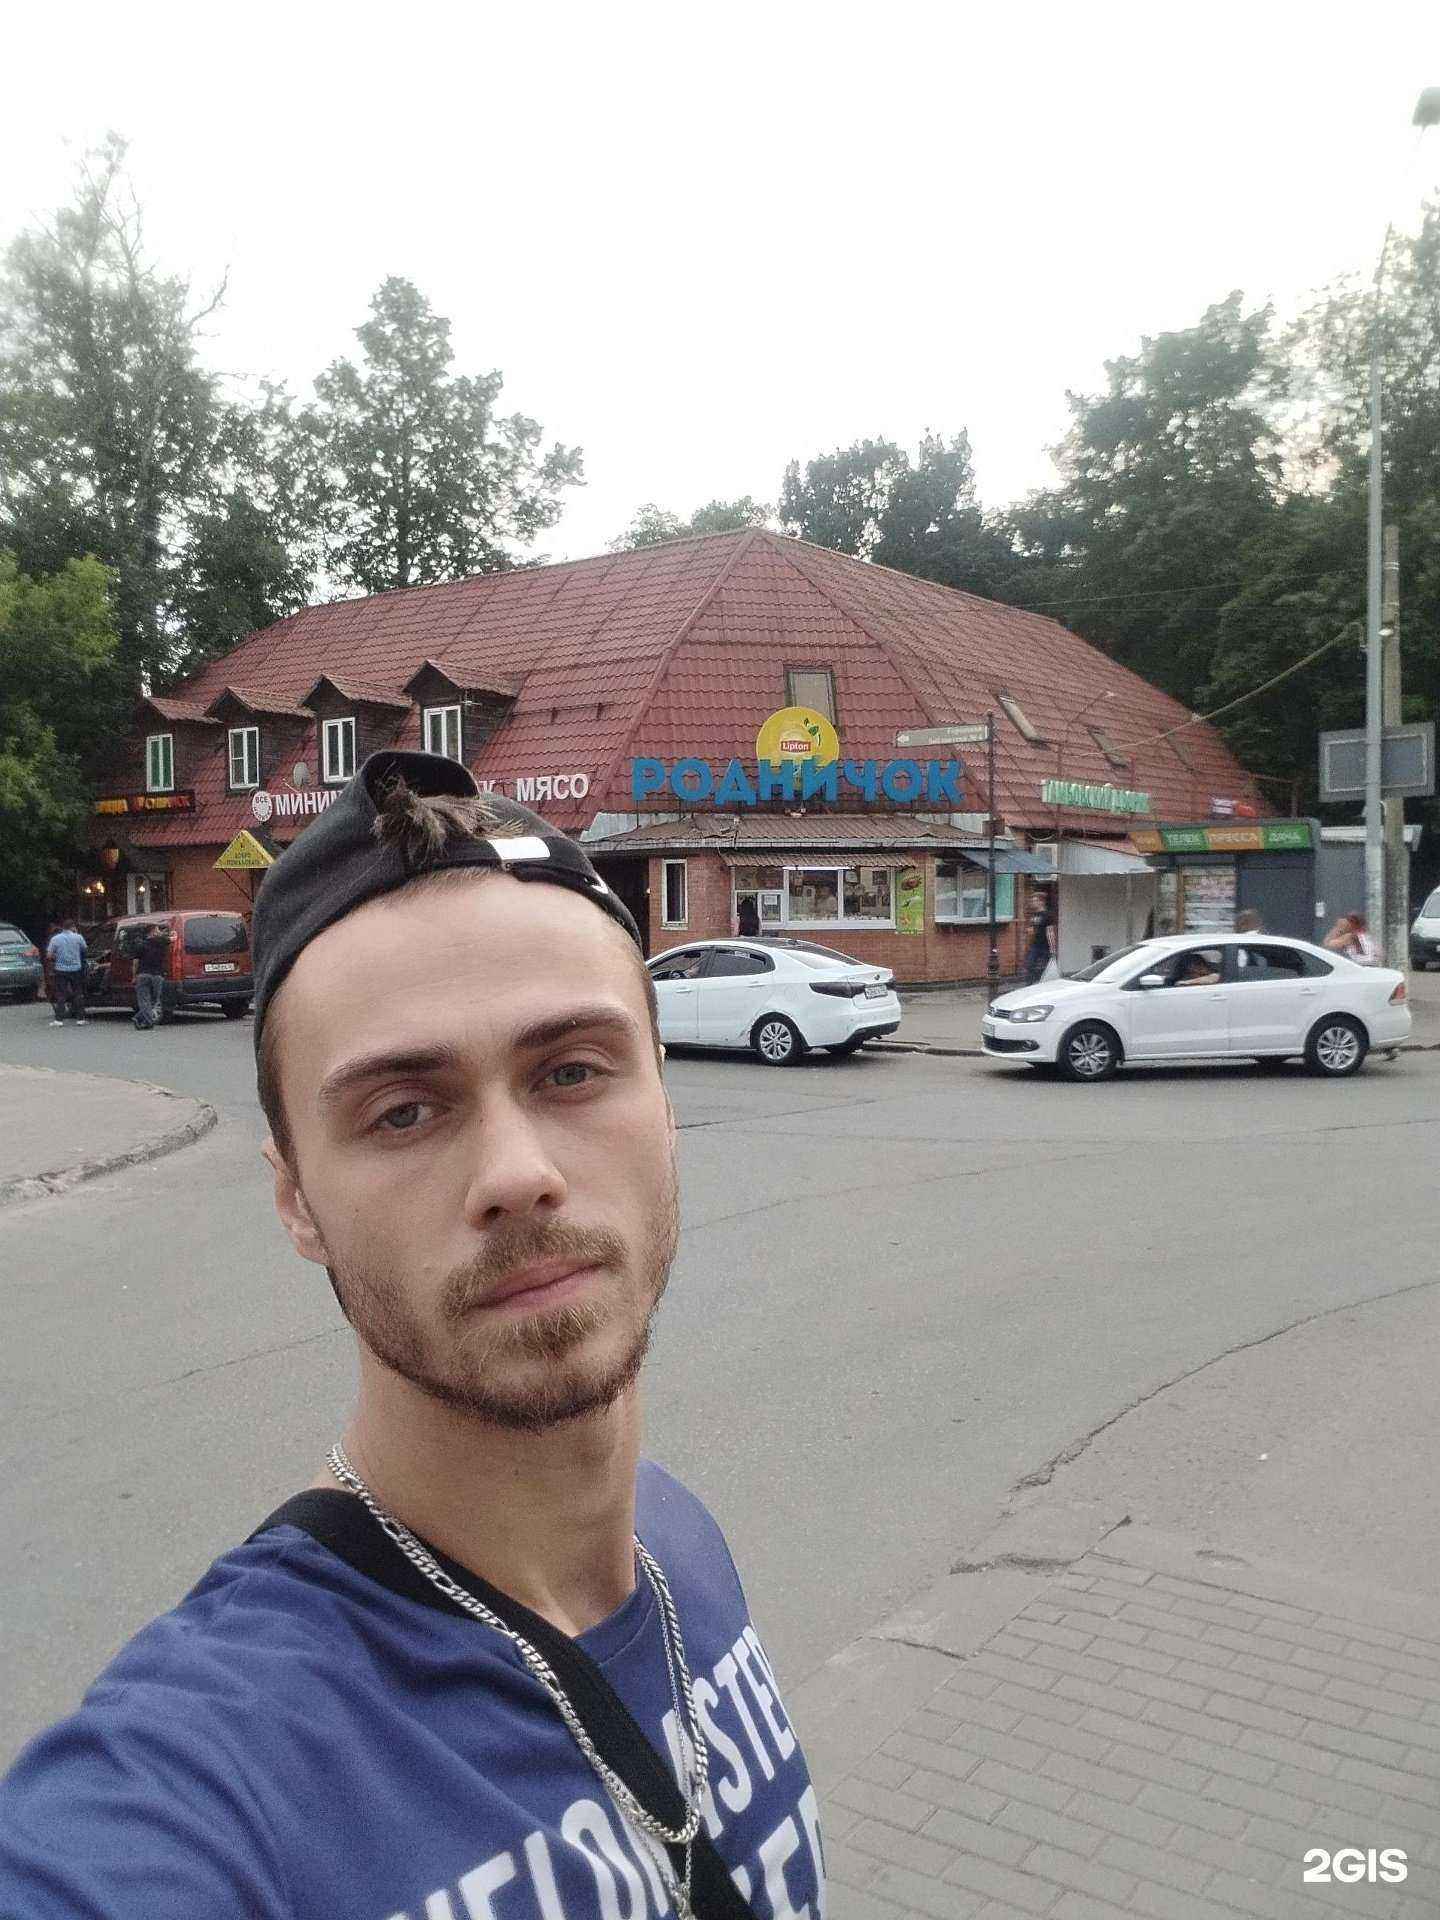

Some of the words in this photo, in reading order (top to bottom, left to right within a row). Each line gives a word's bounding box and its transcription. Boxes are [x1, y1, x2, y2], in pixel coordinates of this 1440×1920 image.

[782, 742, 809, 752] Lipton
[517, 773, 589, 801] МЯСО
[631, 757, 964, 805] РОДНИЧОК
